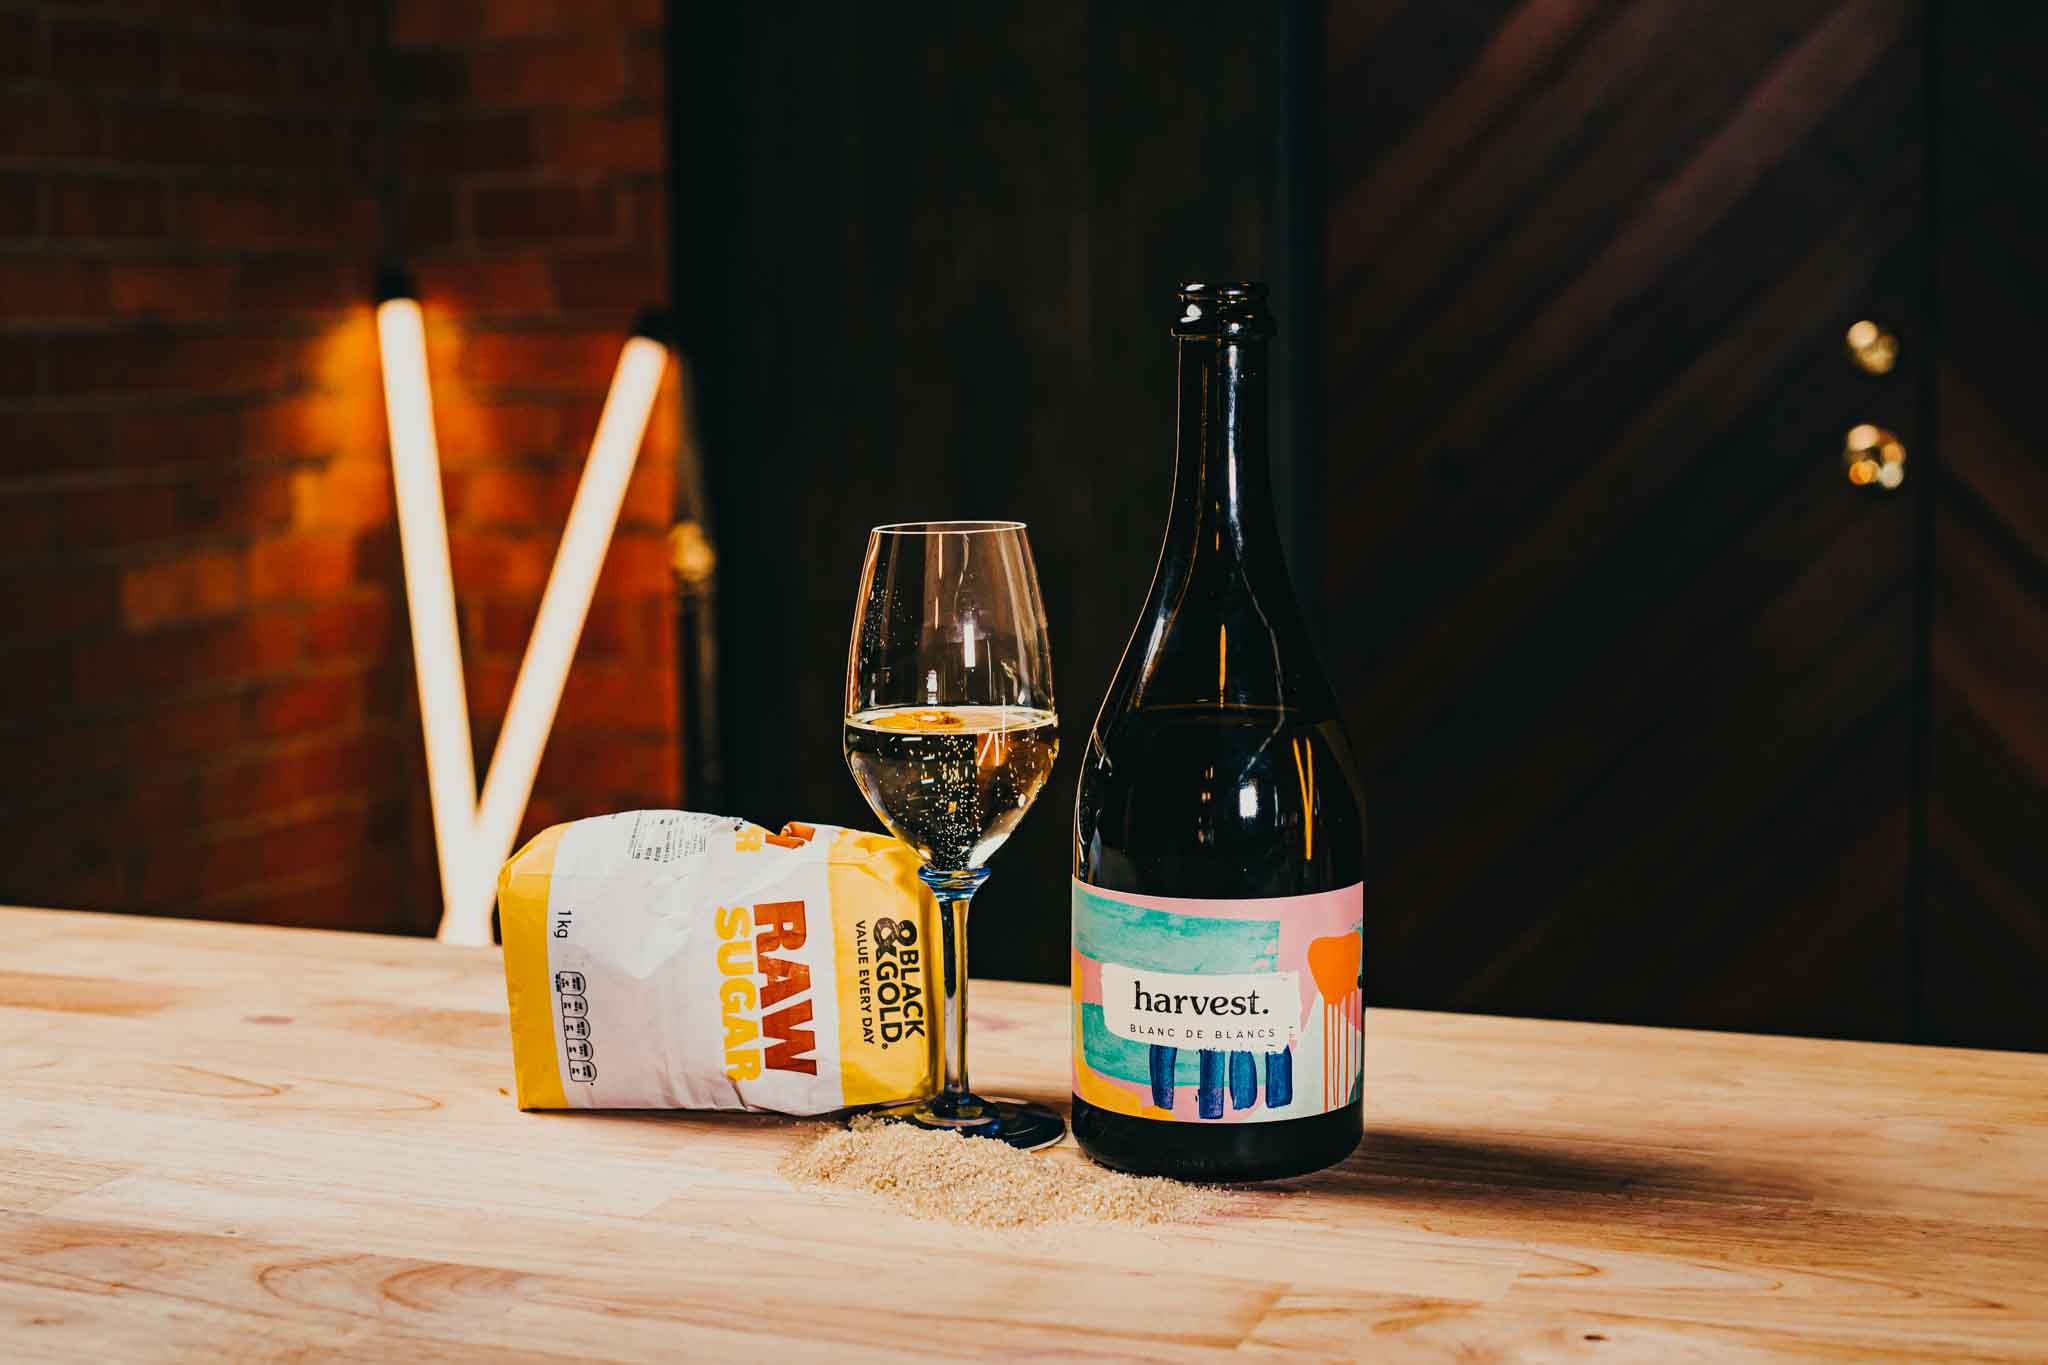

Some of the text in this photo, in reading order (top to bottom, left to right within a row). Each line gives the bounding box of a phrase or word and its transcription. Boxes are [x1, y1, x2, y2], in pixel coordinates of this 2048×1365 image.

[714, 905, 762, 1082] SUGAR
[753, 900, 817, 1077] RAW
[856, 920, 875, 1045] VALUE EVERY DAY
[900, 950, 925, 1040] BLACK
[1130, 1023, 1276, 1040] BLANC DE BLANCS
[1133, 980, 1269, 1016] harvest.
